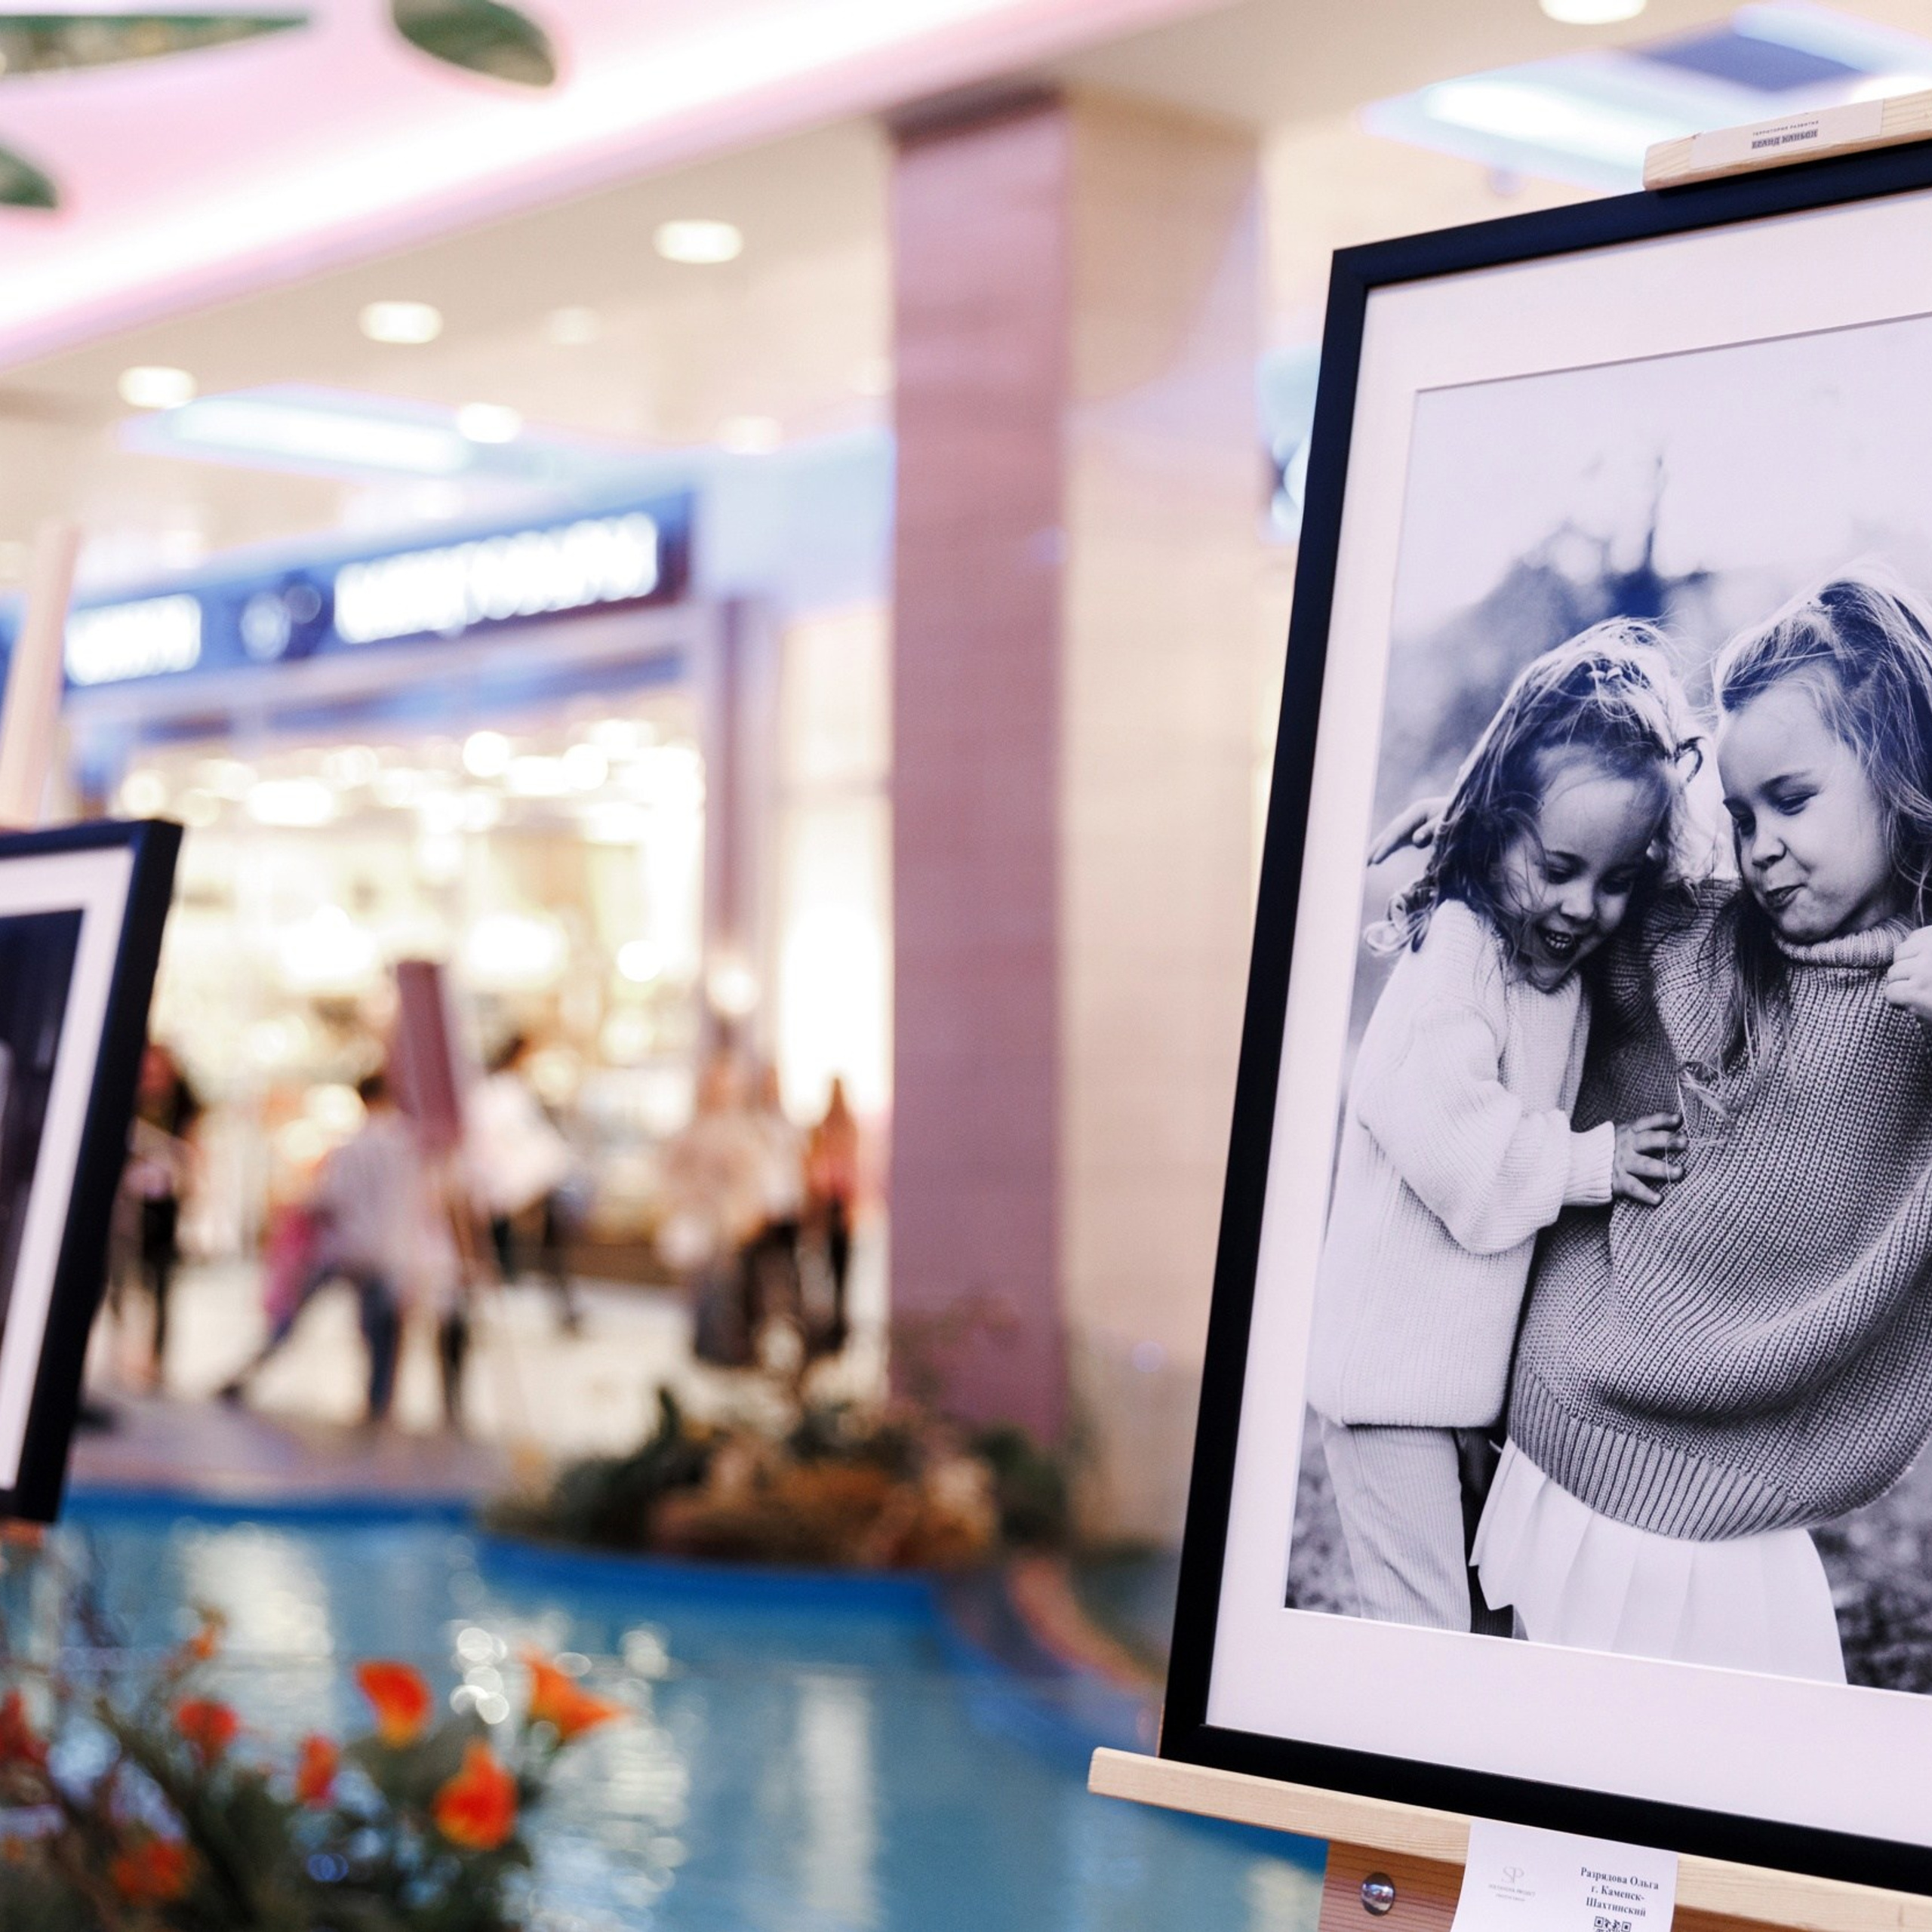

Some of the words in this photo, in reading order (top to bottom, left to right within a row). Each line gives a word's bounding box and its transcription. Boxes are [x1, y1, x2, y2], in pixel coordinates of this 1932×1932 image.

[1580, 1866, 1627, 1884] Разрядова
[1629, 1876, 1659, 1890] Ольга
[1601, 1884, 1645, 1901] Каменск-
[1586, 1897, 1646, 1917] Шахтинский
